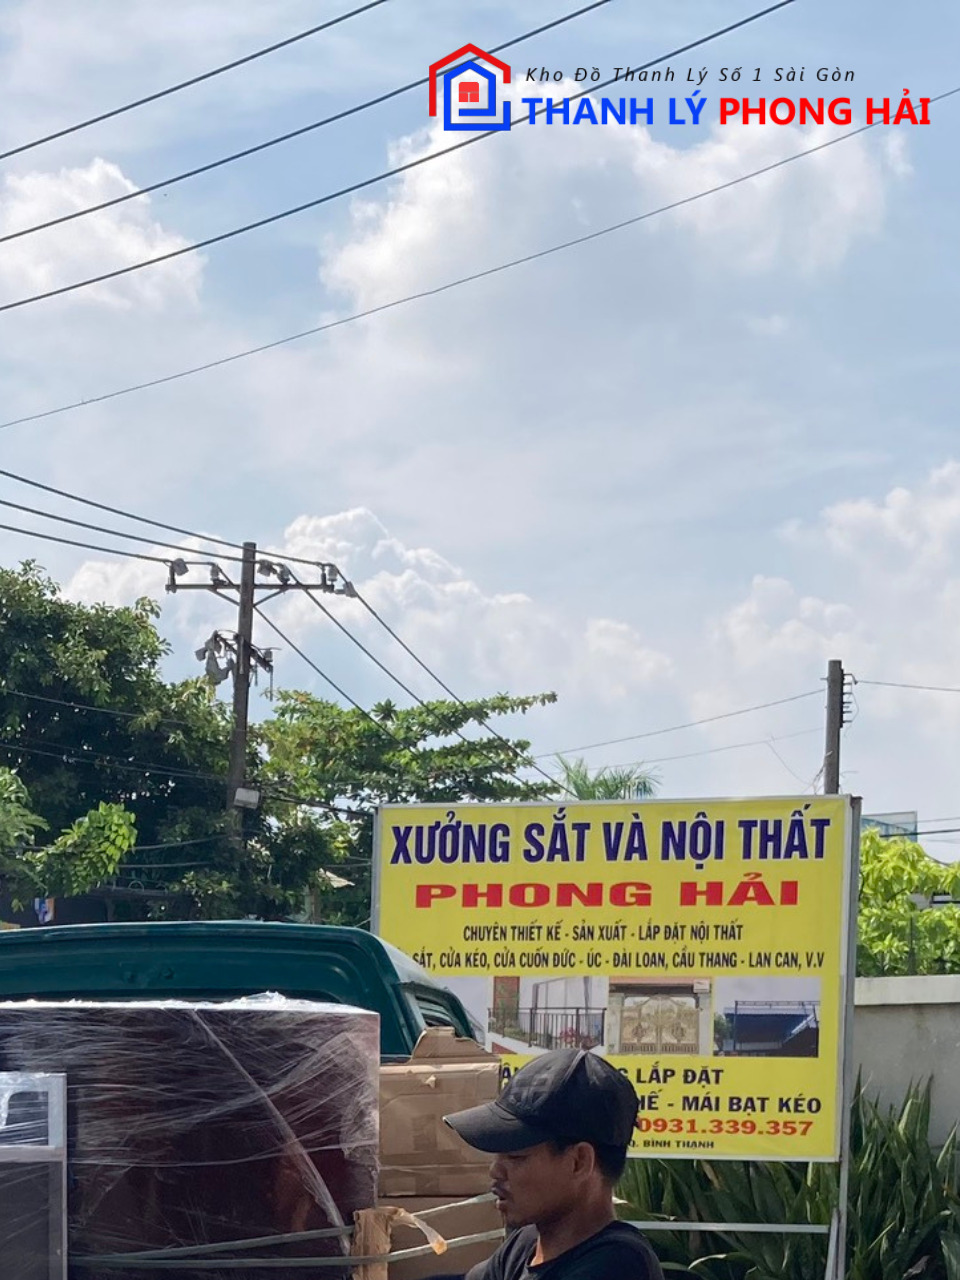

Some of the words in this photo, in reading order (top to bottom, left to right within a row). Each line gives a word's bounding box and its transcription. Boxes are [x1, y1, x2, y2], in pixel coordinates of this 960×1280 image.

[390, 810, 511, 865] XƯỞNG
[523, 807, 591, 863] SẮT
[602, 813, 648, 861] VÀ
[661, 811, 725, 870] NỘI
[738, 803, 831, 860] THẤT
[415, 882, 652, 908] PHONG
[680, 872, 799, 906] HẢI
[463, 922, 506, 942] CHUYÊN
[511, 919, 542, 941] THIẾT
[546, 919, 562, 941] KẾ
[572, 919, 594, 941] SẢN
[598, 919, 627, 941] XUẤT
[639, 918, 660, 940] LẮP
[664, 921, 686, 944] ĐẶT
[691, 921, 709, 944] NỘI
[714, 918, 743, 940] THẤT
[440, 948, 461, 968] CỬA
[465, 949, 490, 970] KÉO,
[494, 948, 515, 968] CỬA
[553, 946, 575, 968] ĐỨC
[587, 947, 601, 967] ÚC
[613, 948, 631, 968] ĐÀI
[636, 952, 668, 971] LOAN,
[699, 952, 737, 968] THANG
[749, 952, 771, 968] LAN
[775, 952, 802, 971] CAN,
[806, 952, 825, 968] V.V
[636, 1061, 676, 1084] LẮP
[683, 1066, 724, 1088] ĐẶT
[682, 1091, 720, 1112] MÁI
[728, 1097, 770, 1116] BẠT
[778, 1093, 822, 1113] KÉO
[637, 1117, 814, 1136] 0931.339.357
[643, 1138, 671, 1148] BÌNH
